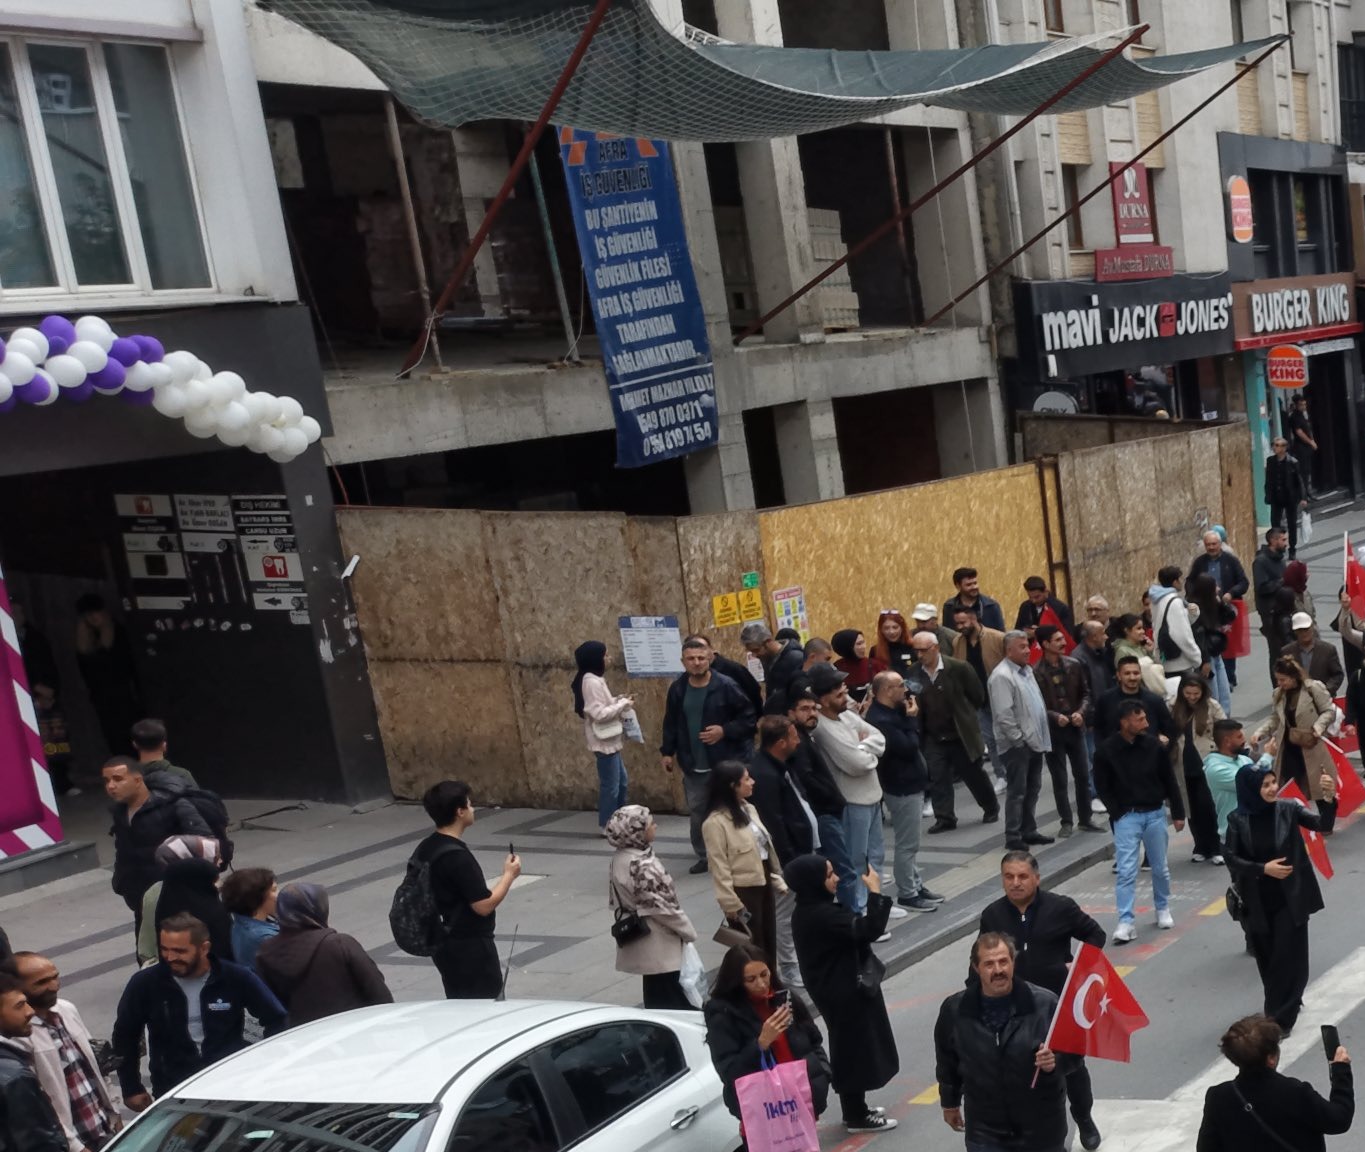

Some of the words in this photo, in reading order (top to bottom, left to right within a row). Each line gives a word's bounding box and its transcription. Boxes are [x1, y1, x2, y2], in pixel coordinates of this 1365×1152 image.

[585, 208, 600, 230] BU
[1119, 203, 1149, 218] DURNA
[1252, 288, 1312, 333] BURGER
[1316, 284, 1350, 324] KING
[616, 313, 677, 344] TARAFINDAN
[1042, 294, 1103, 351] mavi
[1108, 304, 1160, 344] JACK
[1268, 358, 1305, 369] BURGER
[1269, 368, 1305, 380] KING
[693, 420, 712, 442] 54
